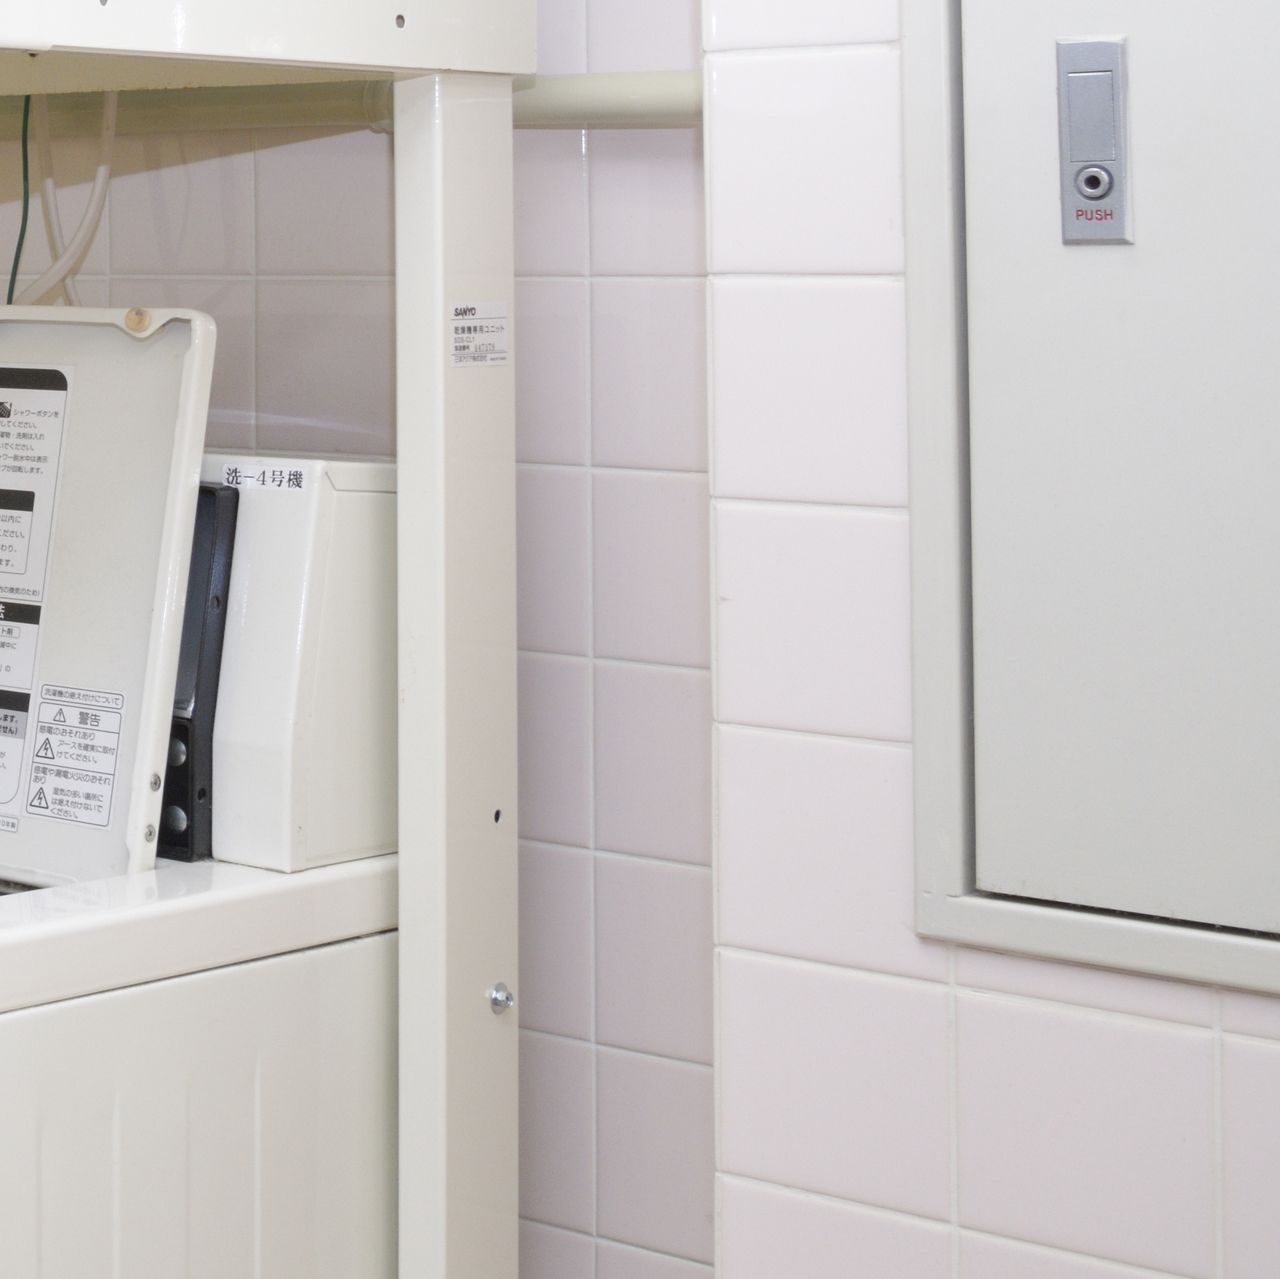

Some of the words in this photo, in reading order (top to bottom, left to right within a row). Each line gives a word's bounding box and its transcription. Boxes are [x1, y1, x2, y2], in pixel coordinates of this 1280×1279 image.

[1076, 210, 1113, 221] PUSH
[454, 305, 476, 317] SANYO
[226, 468, 303, 488] 洗-4号機
[78, 711, 101, 727] 警告
